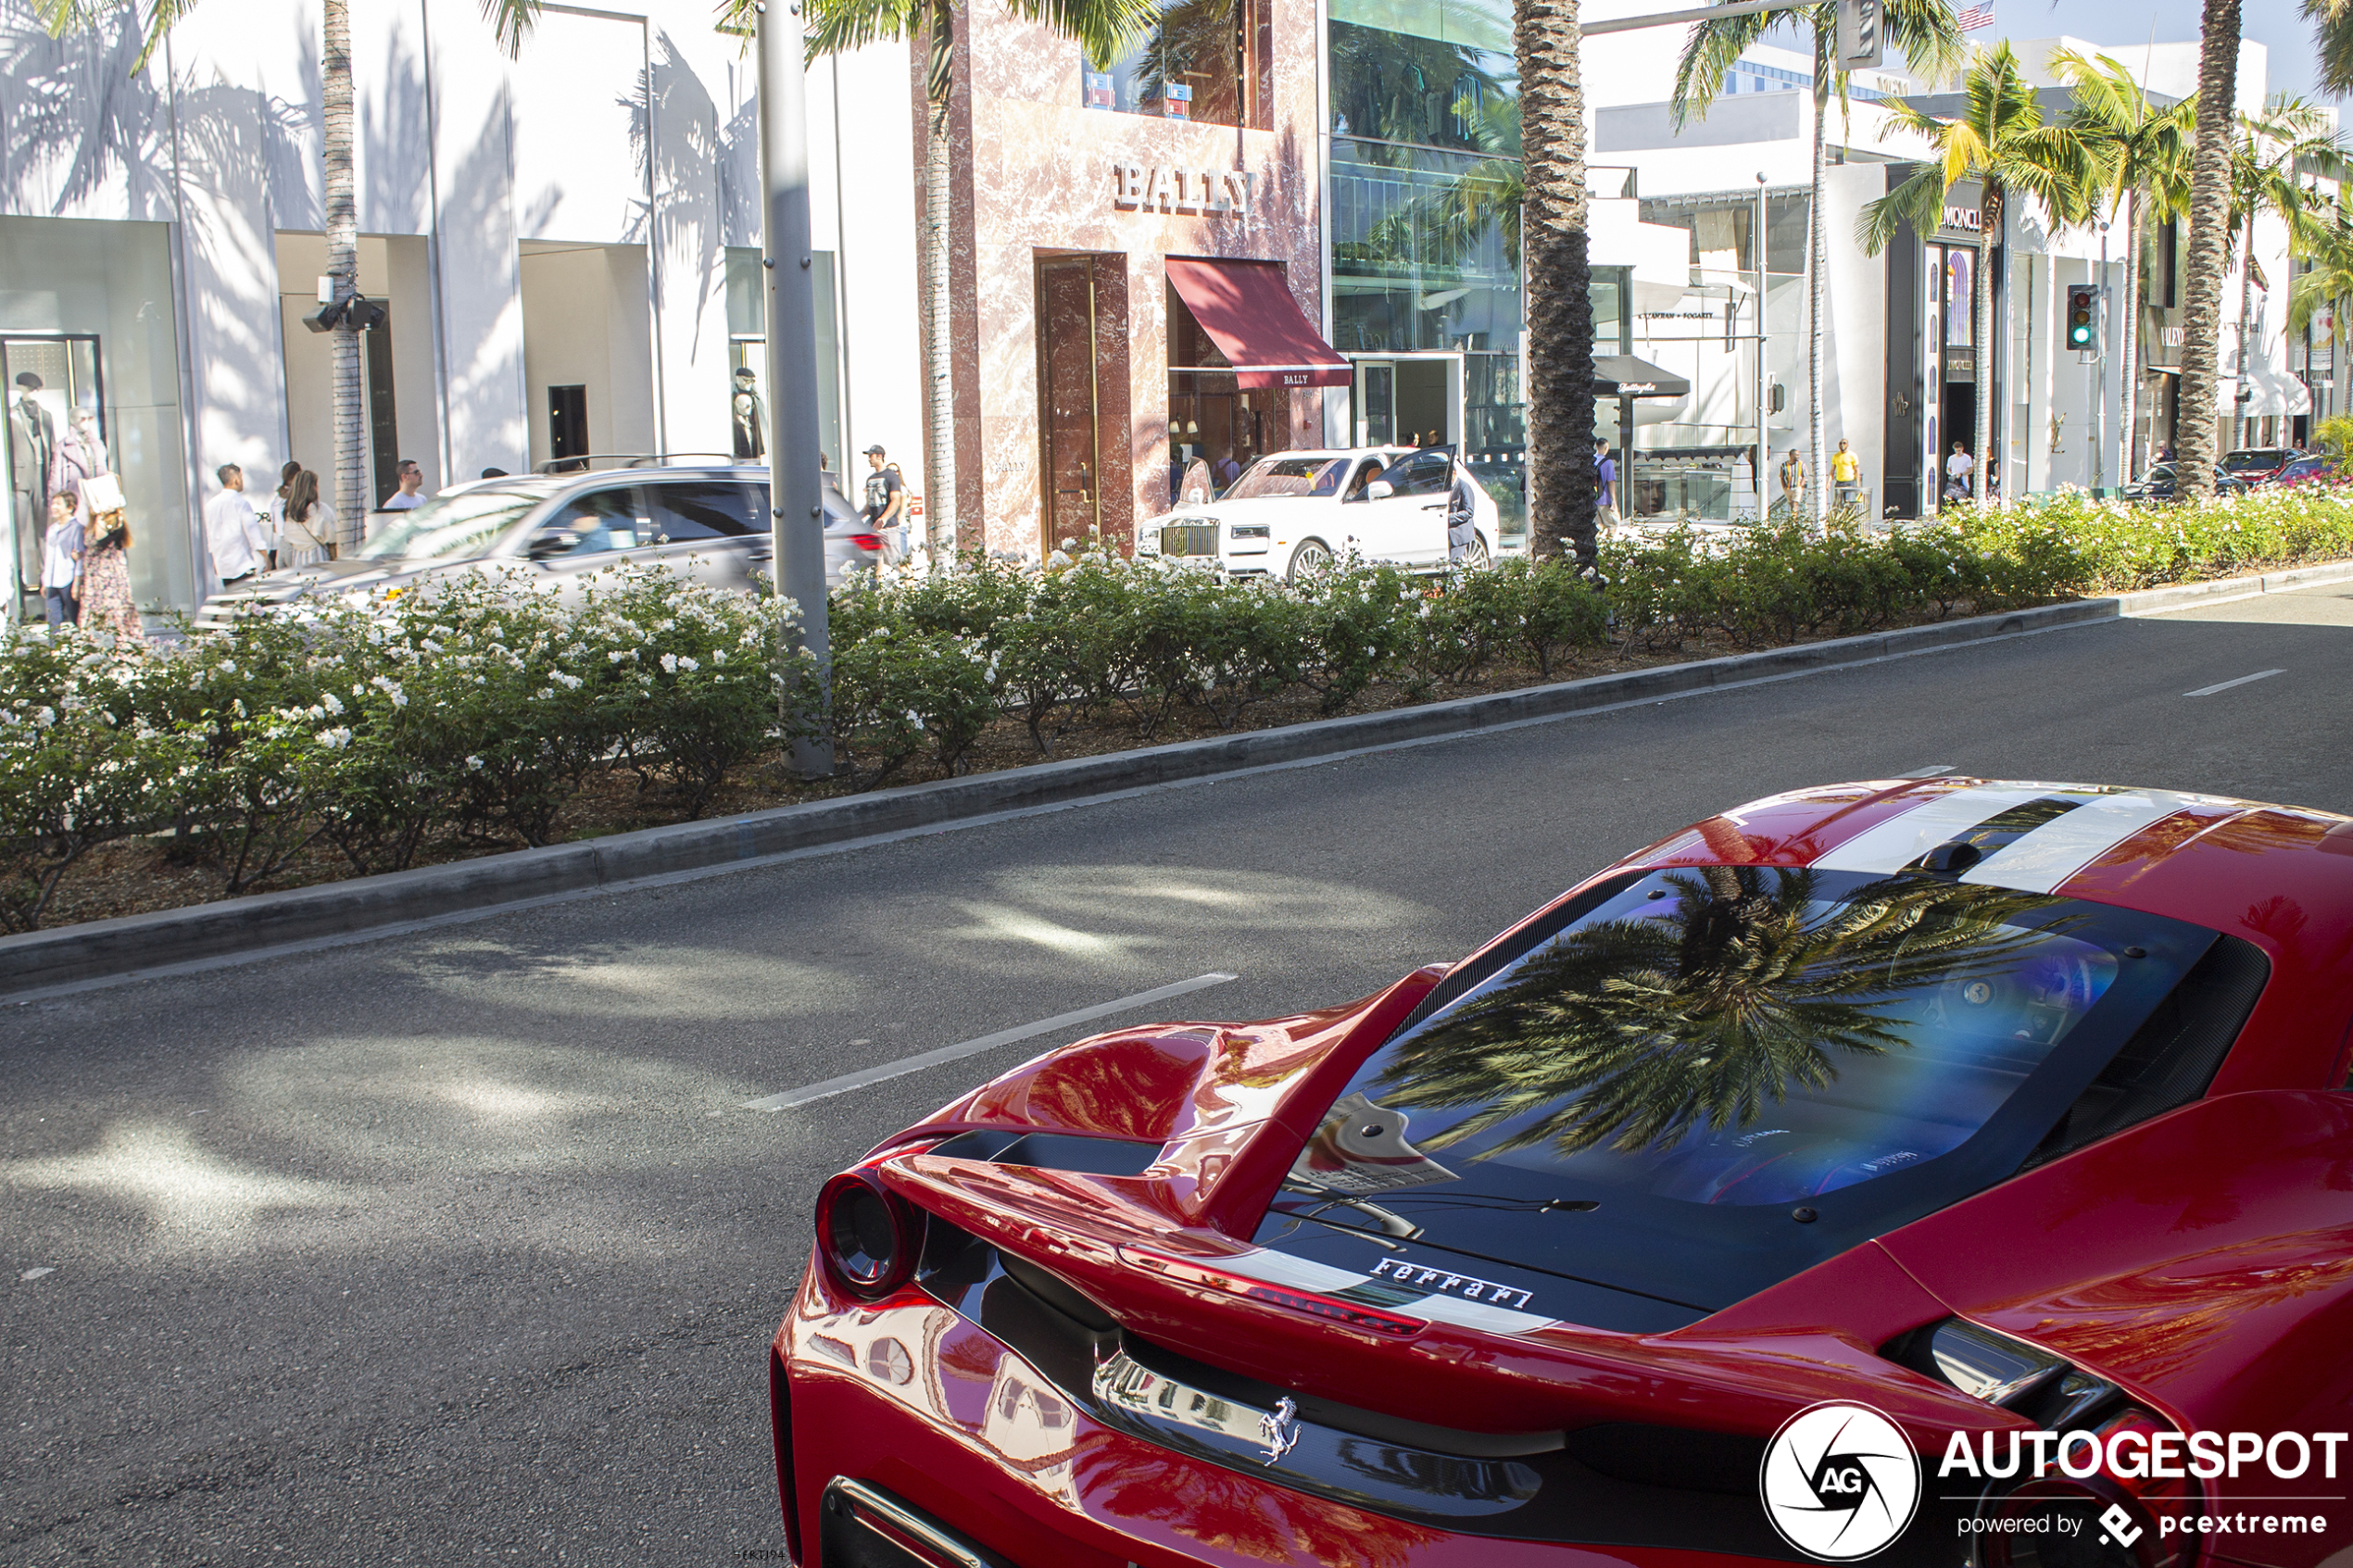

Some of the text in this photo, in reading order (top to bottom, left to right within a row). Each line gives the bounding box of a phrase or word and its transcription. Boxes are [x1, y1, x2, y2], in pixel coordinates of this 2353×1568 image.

[1117, 159, 1258, 215] BALLY
[1942, 205, 1982, 230] MONCL
[2160, 326, 2185, 347] VALEN
[1283, 374, 1308, 385] BALLY
[1368, 1256, 1534, 1311] Ferrari
